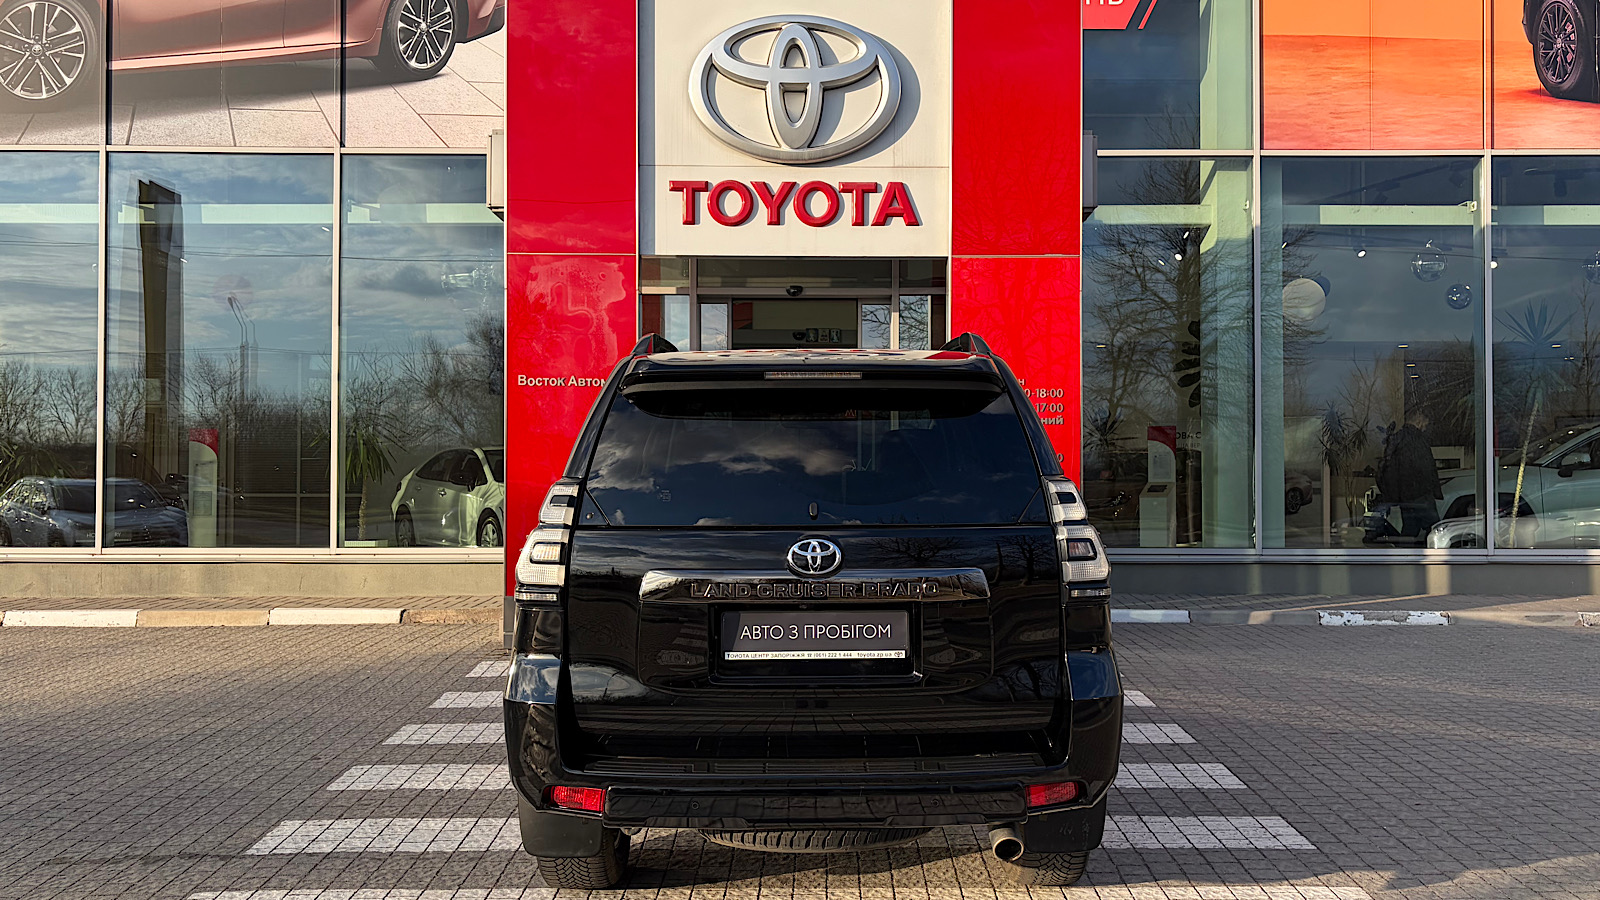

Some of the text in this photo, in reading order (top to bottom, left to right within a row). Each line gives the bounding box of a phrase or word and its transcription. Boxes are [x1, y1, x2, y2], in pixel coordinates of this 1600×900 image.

[668, 179, 921, 228] TOYOTA
[517, 374, 566, 387] Восток
[690, 581, 940, 598] LAND CRUISER PRADO
[740, 625, 784, 640] АВТО
[804, 624, 891, 639] ПРОБІГОМ
